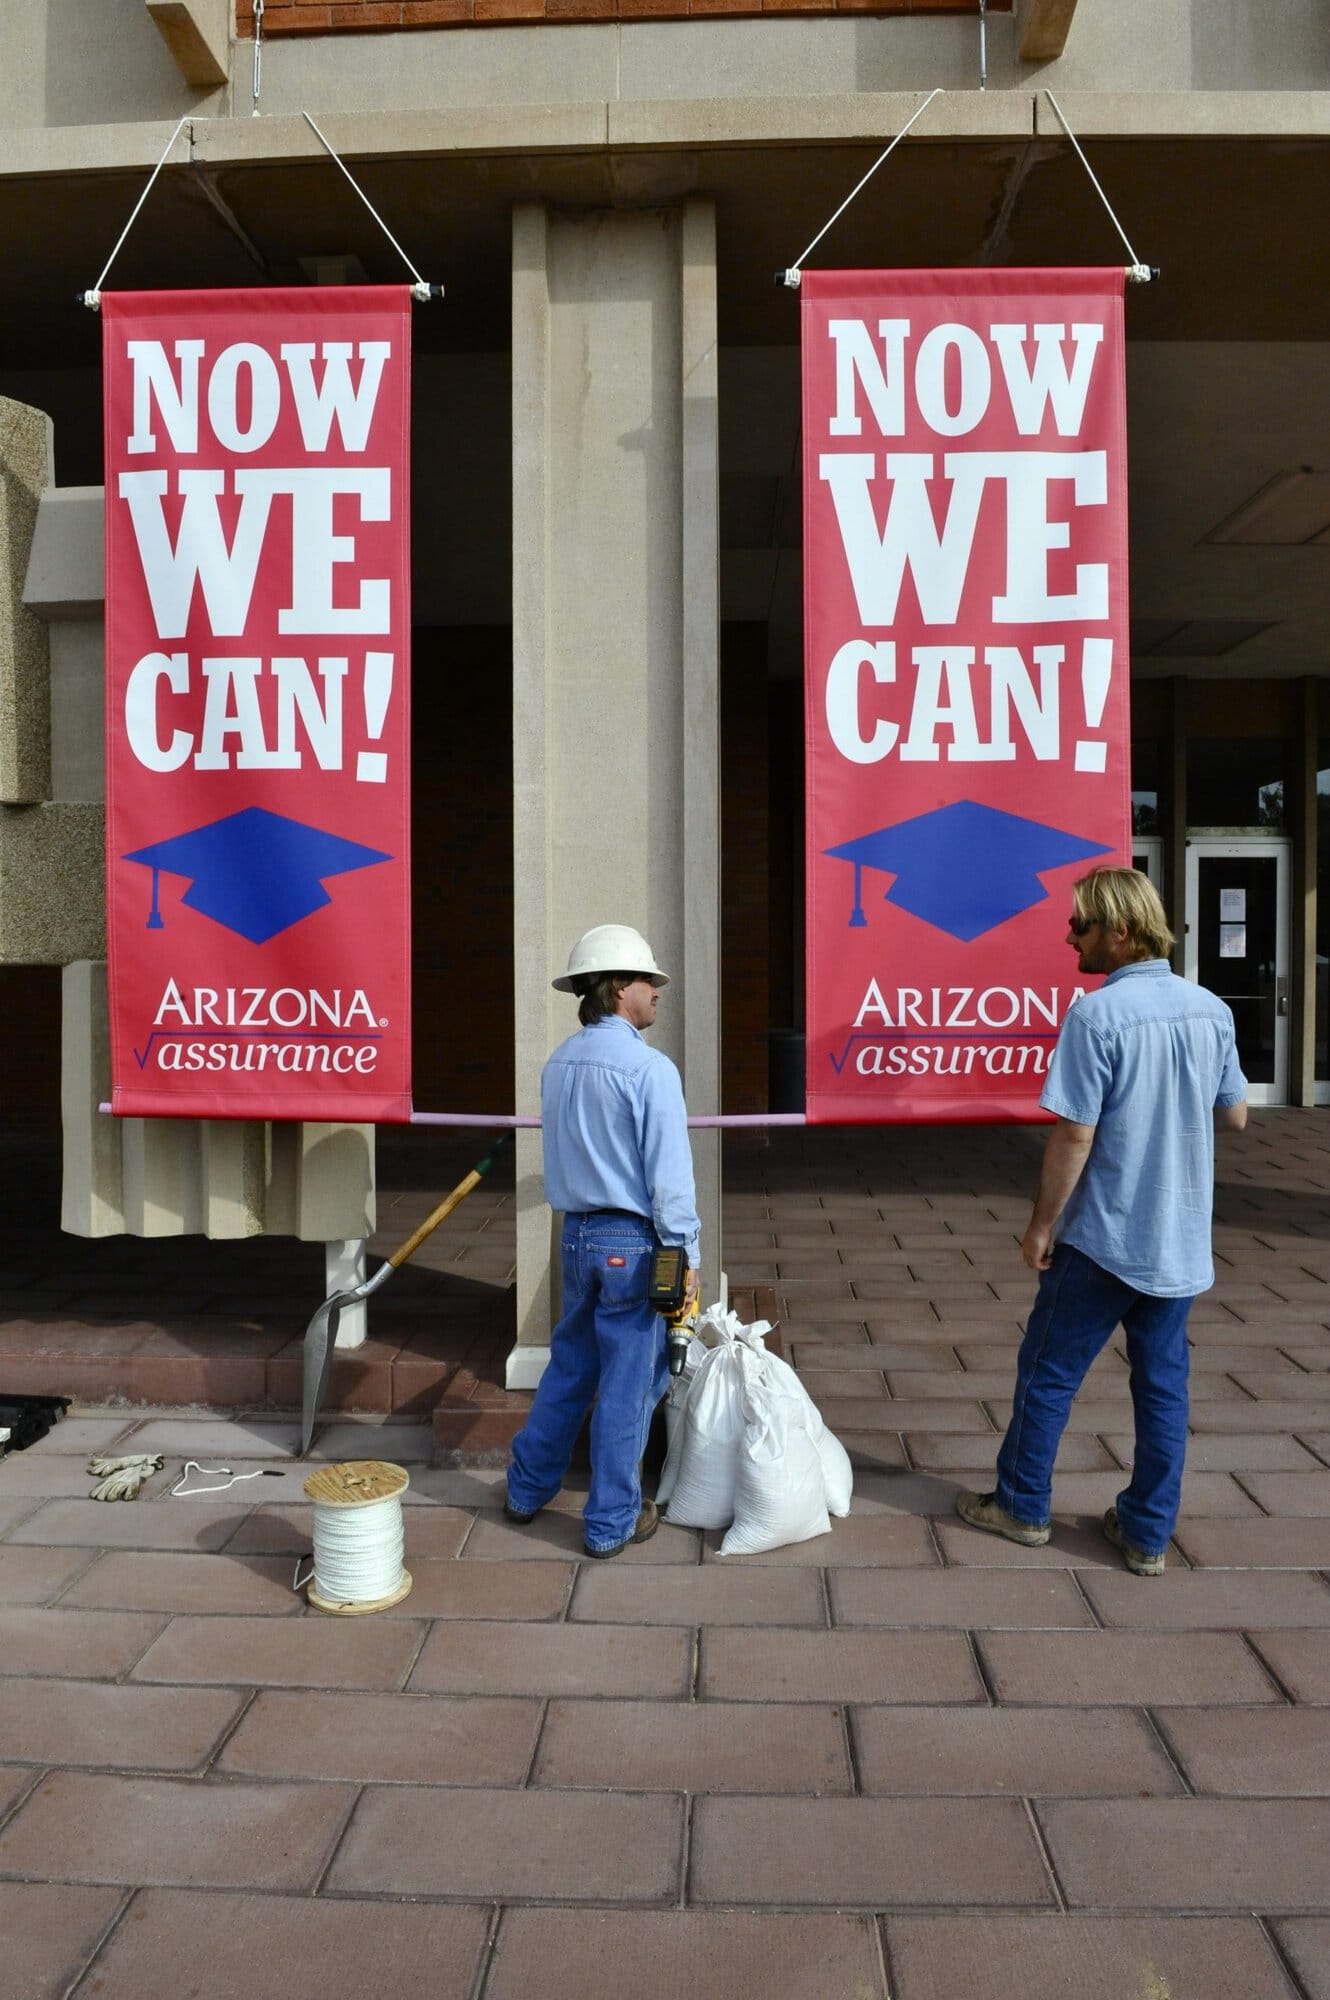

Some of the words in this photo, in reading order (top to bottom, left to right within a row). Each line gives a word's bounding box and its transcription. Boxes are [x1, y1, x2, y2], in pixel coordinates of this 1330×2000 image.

[127, 339, 392, 455] NOW
[827, 318, 1105, 437] NOW
[118, 466, 392, 639] WE
[818, 449, 1110, 627] WE
[124, 651, 395, 784] CAN!
[825, 637, 1114, 774] CAN!
[157, 1043, 378, 1074] assurance
[856, 1045, 1055, 1075] assuran
